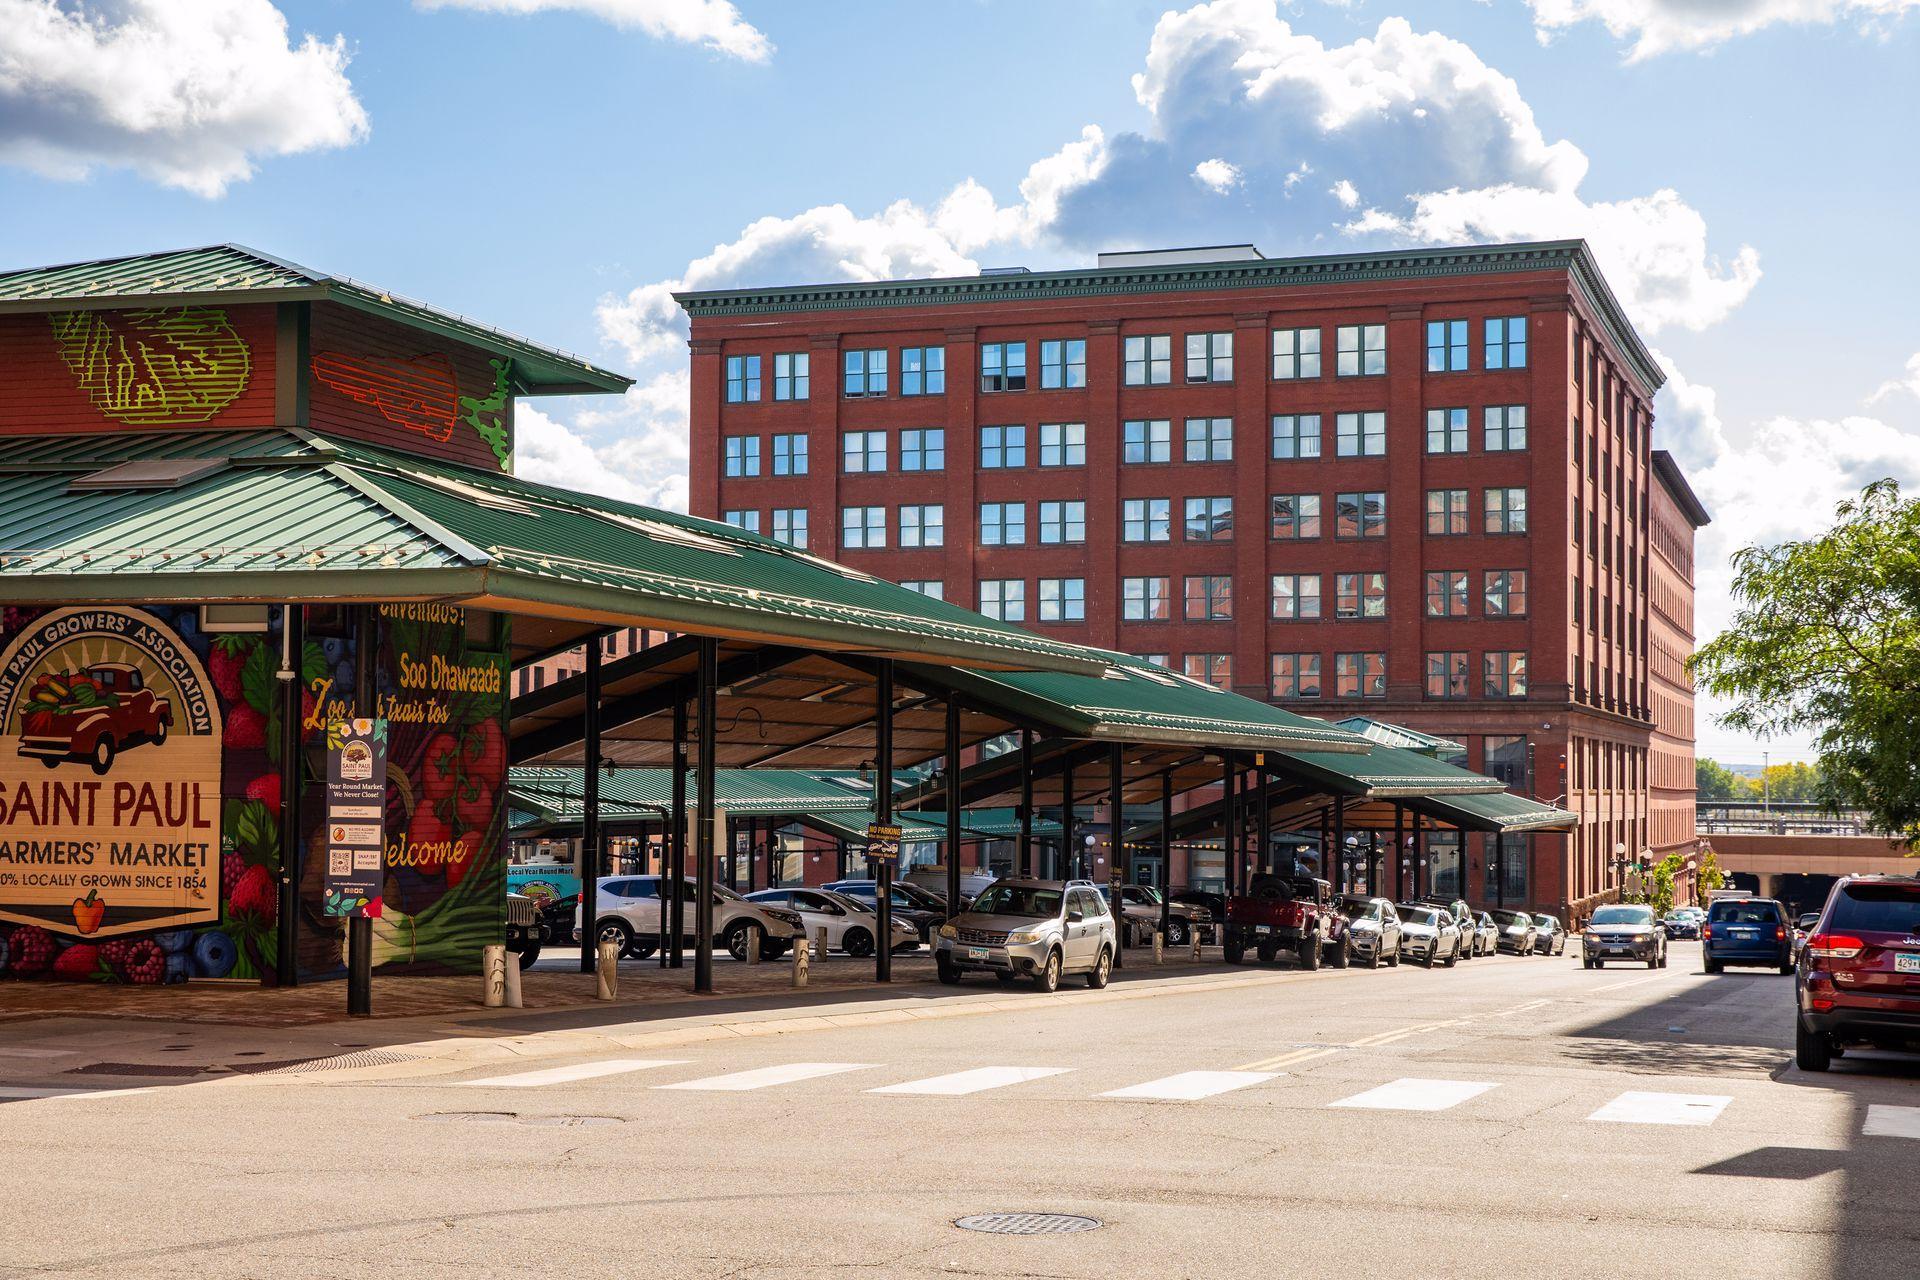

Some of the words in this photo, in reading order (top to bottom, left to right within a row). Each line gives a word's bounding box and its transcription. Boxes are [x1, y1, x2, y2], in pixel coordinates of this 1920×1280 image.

[9, 638, 45, 675] PAUL
[44, 613, 132, 643] GROWERS'
[134, 626, 210, 732] ASSOCIATION
[400, 652, 428, 690] Soo
[431, 654, 501, 694] Dhawaada
[304, 677, 346, 730] Zoo
[386, 694, 427, 723] txais
[427, 697, 451, 724] tos
[113, 781, 211, 828] PAUL
[110, 842, 209, 867] MARKET
[384, 832, 469, 867] elcome
[22, 874, 77, 887] LOCALLY
[81, 874, 131, 888] GROWN
[135, 875, 173, 889] SINCE
[177, 875, 207, 889] 1854
